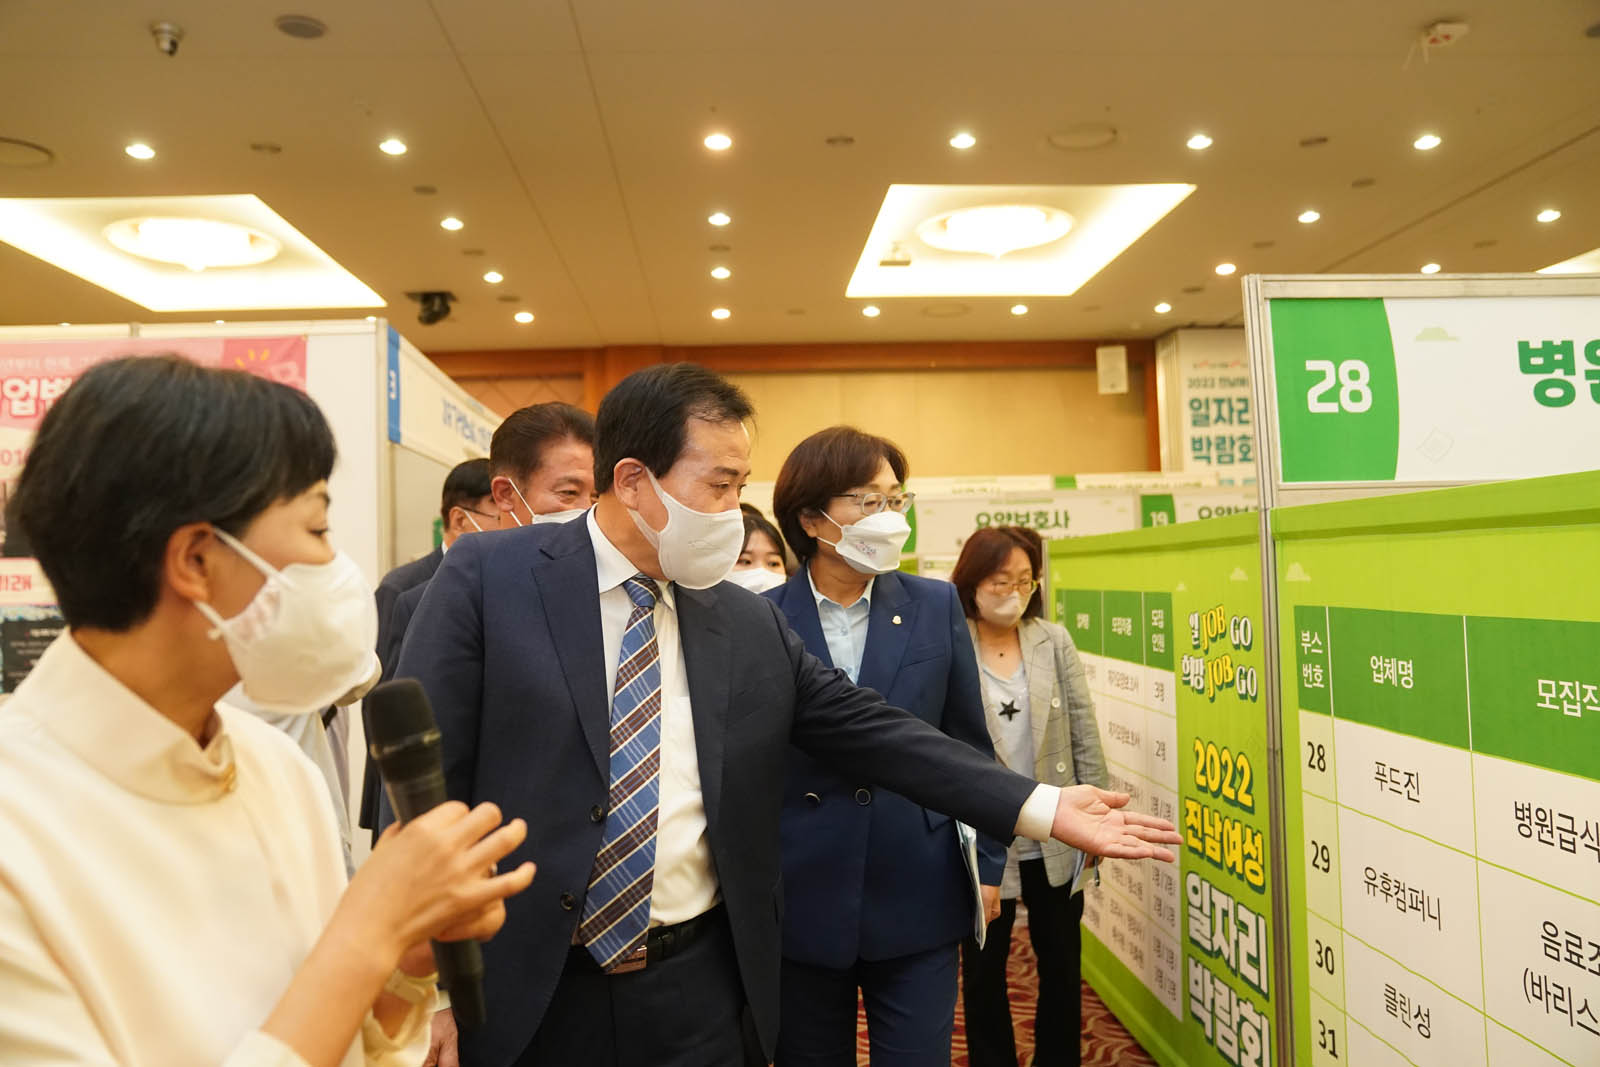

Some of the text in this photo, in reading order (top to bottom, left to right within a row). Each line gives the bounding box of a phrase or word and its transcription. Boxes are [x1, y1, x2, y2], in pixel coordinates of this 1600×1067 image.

[1305, 359, 1373, 414] 28
[1517, 339, 1600, 408] 병
[1202, 604, 1227, 653] JOB
[1229, 615, 1252, 651] GO
[1301, 630, 1324, 655] 부스
[1206, 654, 1235, 701] JOB
[1235, 664, 1258, 701] GO
[1302, 663, 1326, 689] 번호
[1370, 655, 1415, 689] 업체명
[1194, 737, 1254, 813] 2022
[1307, 741, 1327, 773] 28
[1374, 761, 1420, 803] 푸드진
[1185, 797, 1265, 893] 전남여성
[1311, 840, 1331, 874] 29
[1363, 866, 1441, 931] 유후컴퍼니
[1186, 871, 1270, 1002] 일자리
[1315, 939, 1335, 976] 30
[1188, 954, 1272, 1067] 박람회
[1384, 983, 1431, 1039] 클린성
[1318, 1019, 1338, 1060] 31
